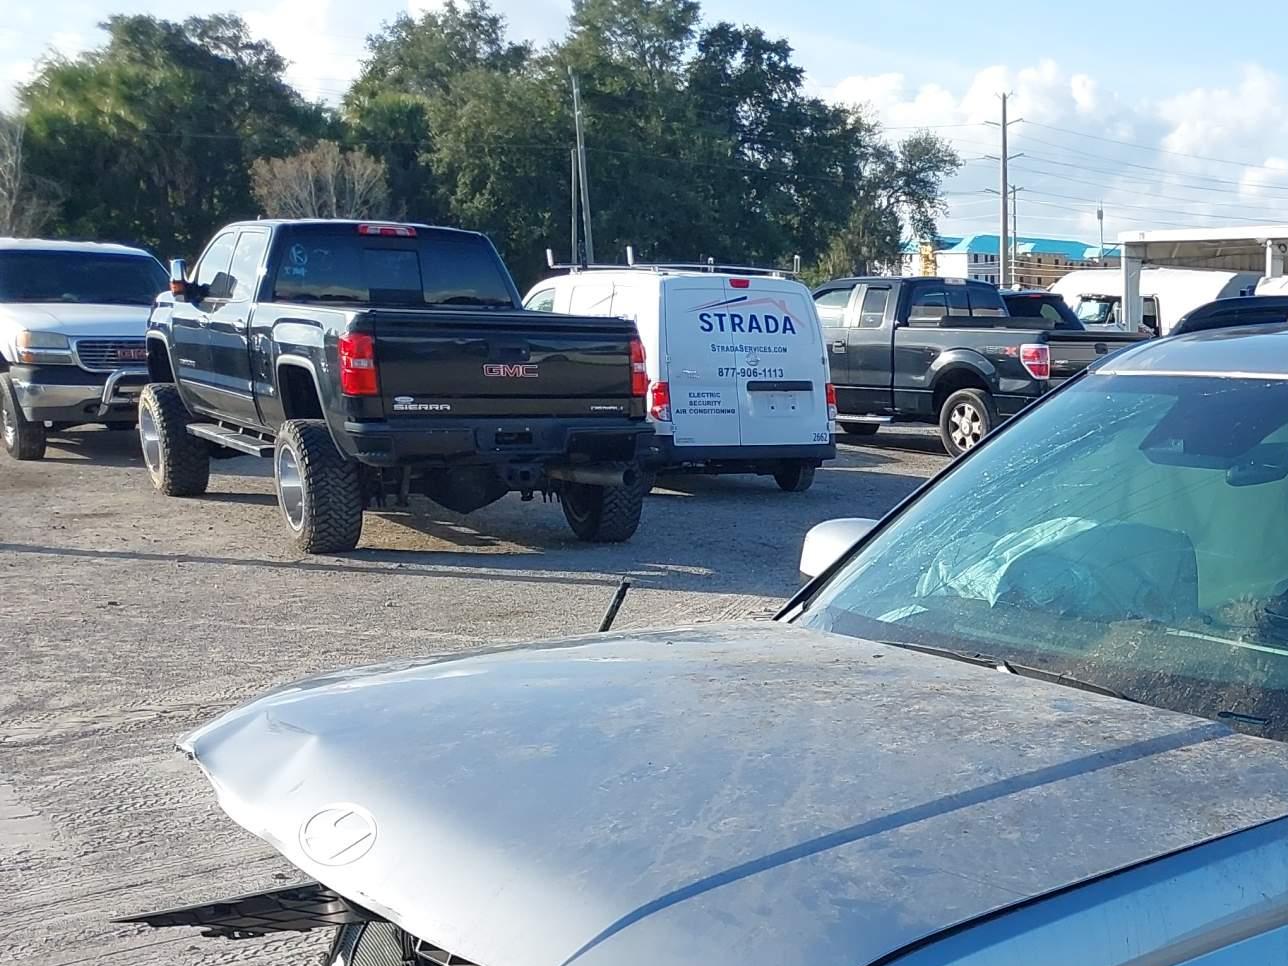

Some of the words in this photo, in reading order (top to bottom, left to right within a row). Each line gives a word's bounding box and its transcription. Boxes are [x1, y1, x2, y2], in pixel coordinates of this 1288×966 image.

[699, 312, 796, 334] STRADA
[483, 364, 539, 377] GMC
[718, 367, 784, 378] 877-906-1113
[812, 432, 828, 442] 2662
